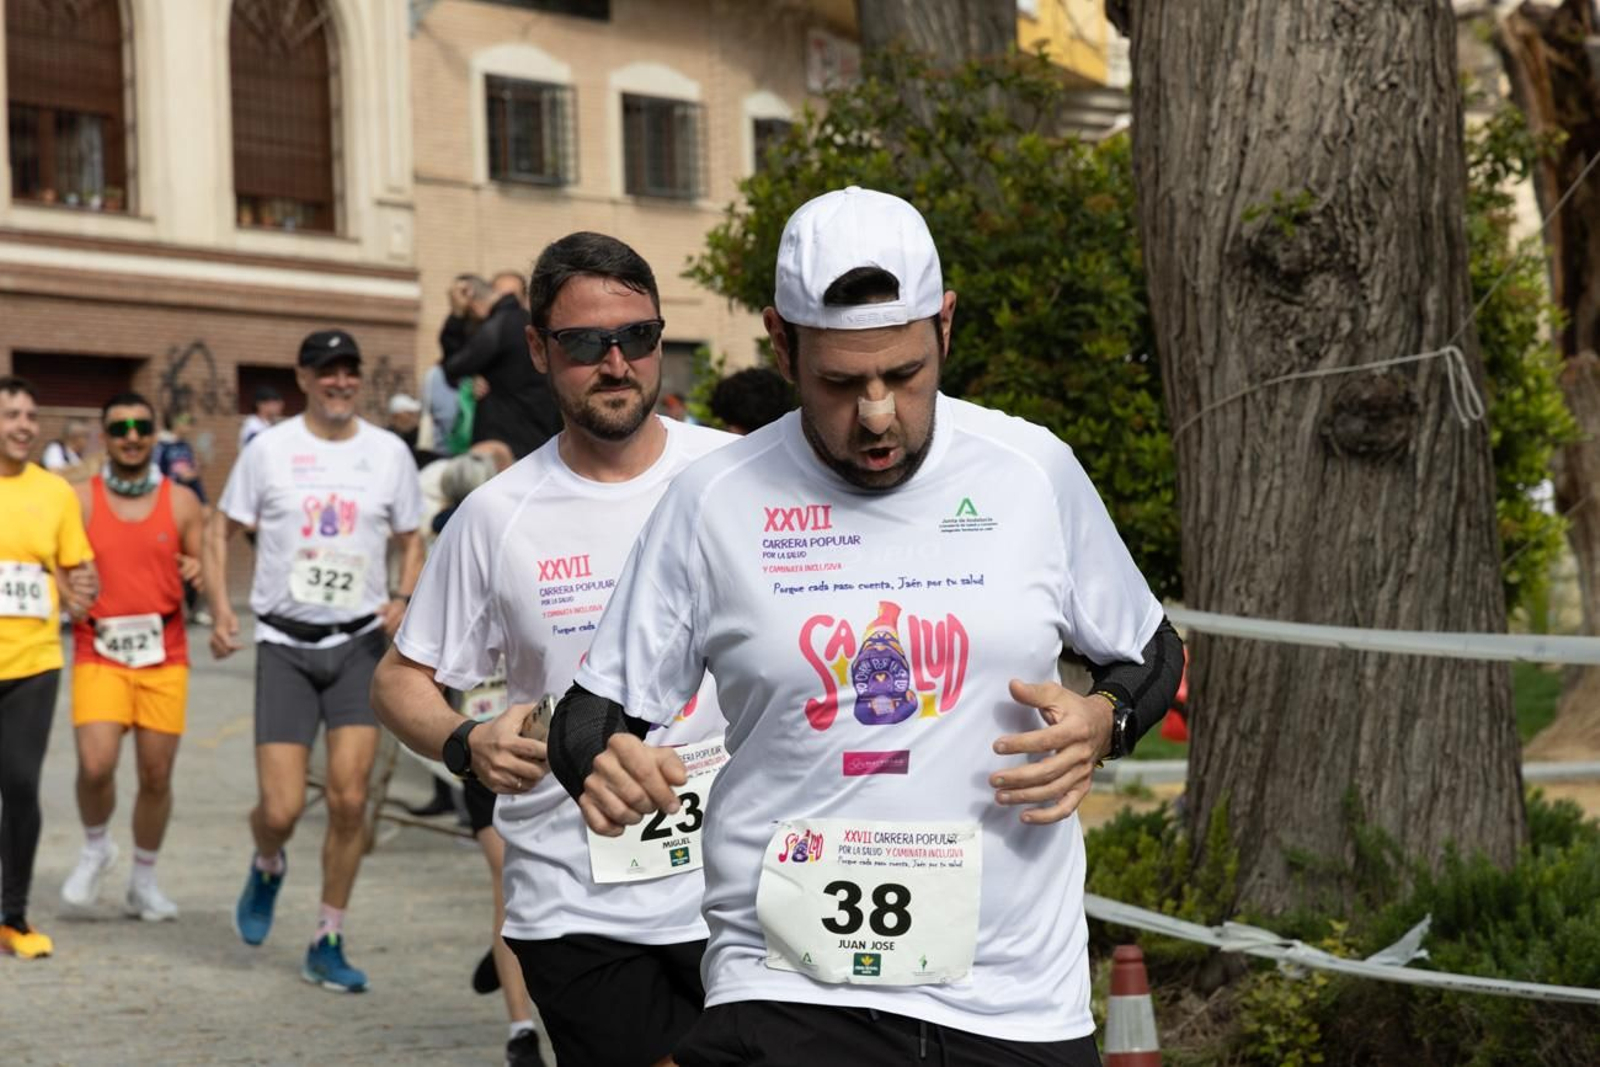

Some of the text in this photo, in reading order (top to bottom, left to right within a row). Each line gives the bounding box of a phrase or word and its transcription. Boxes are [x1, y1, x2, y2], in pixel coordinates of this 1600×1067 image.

[764, 504, 832, 532] XXVII
[762, 535, 861, 549] CARRERA POPULAR
[786, 551, 807, 559] SALUD
[537, 554, 592, 581] XXVII
[307, 566, 354, 591] 322
[774, 574, 984, 595] Porque cada paso cuenta, Jaén por tu salud
[540, 579, 615, 598] CARRERA POPULAR
[579, 620, 596, 632] cada
[106, 634, 149, 651] 482
[799, 613, 969, 731] SALUD
[640, 792, 704, 842] 23
[662, 838, 692, 849] MIGUEL
[844, 830, 957, 845] XXVII CARRERA POPULR
[838, 846, 963, 858] POR LA SALUD Y CAMINATA INCLUSIVA
[820, 880, 912, 937] 38
[838, 939, 896, 951] JUAN JOSE
